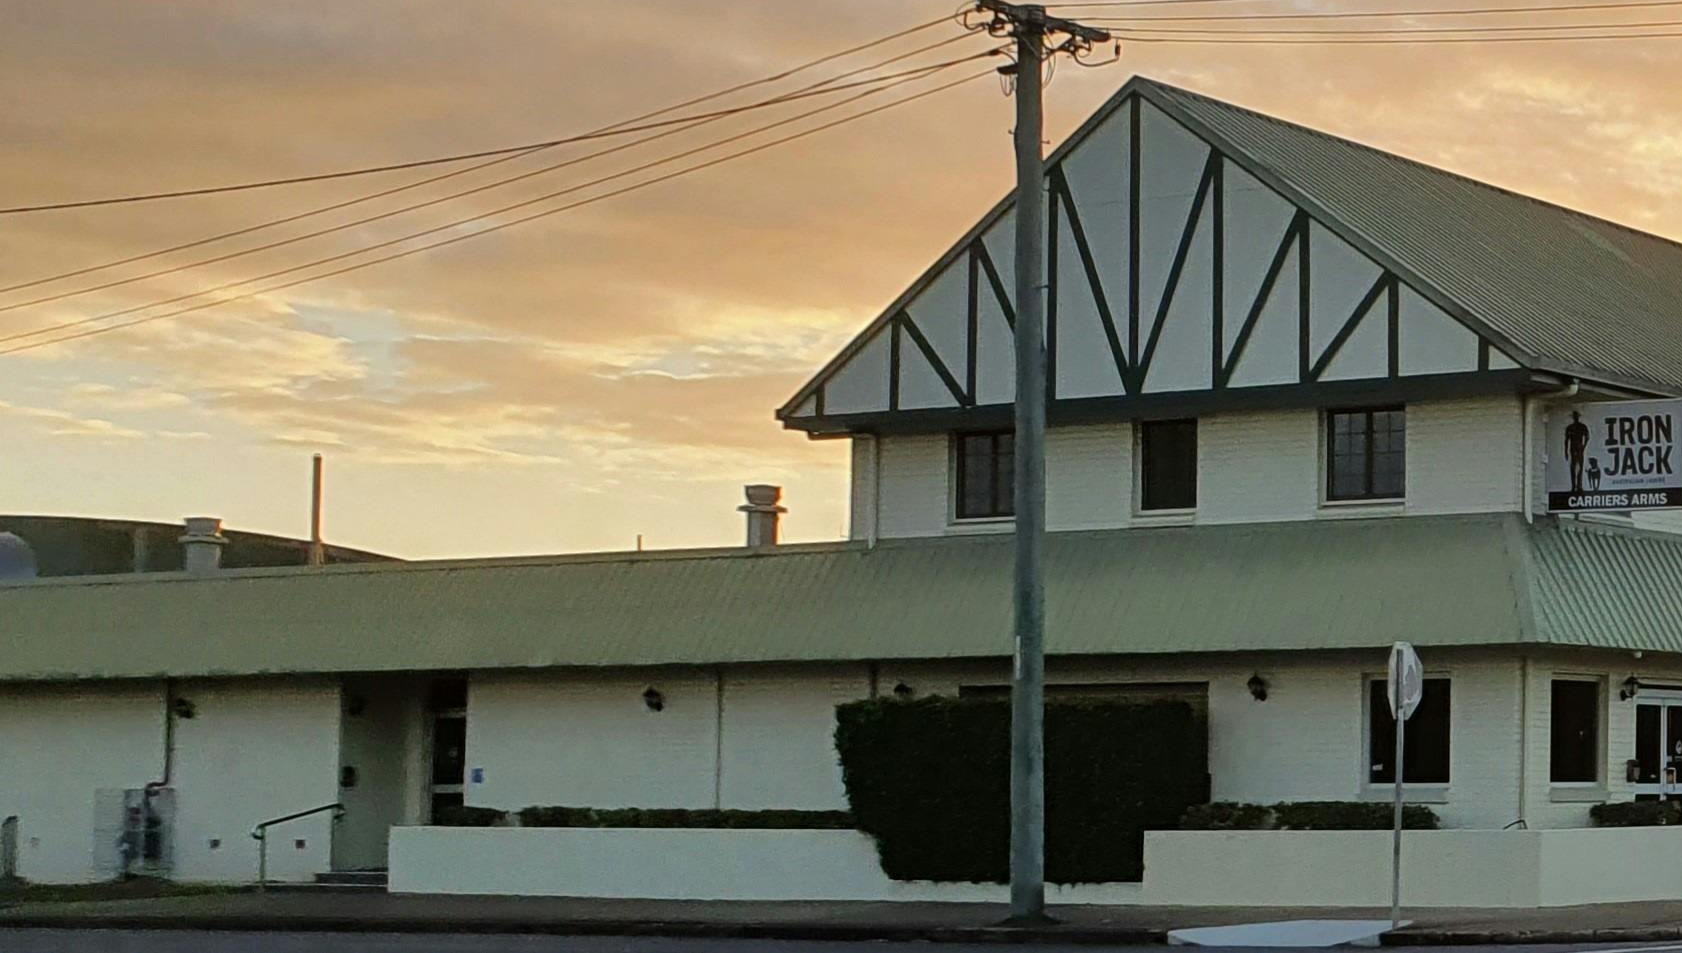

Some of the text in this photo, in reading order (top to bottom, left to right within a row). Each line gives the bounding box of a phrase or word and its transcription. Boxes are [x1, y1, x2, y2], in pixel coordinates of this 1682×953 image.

[1604, 415, 1673, 446] IRON
[1604, 446, 1673, 476] JACK
[1568, 492, 1668, 508] CARRIERS ARMS
